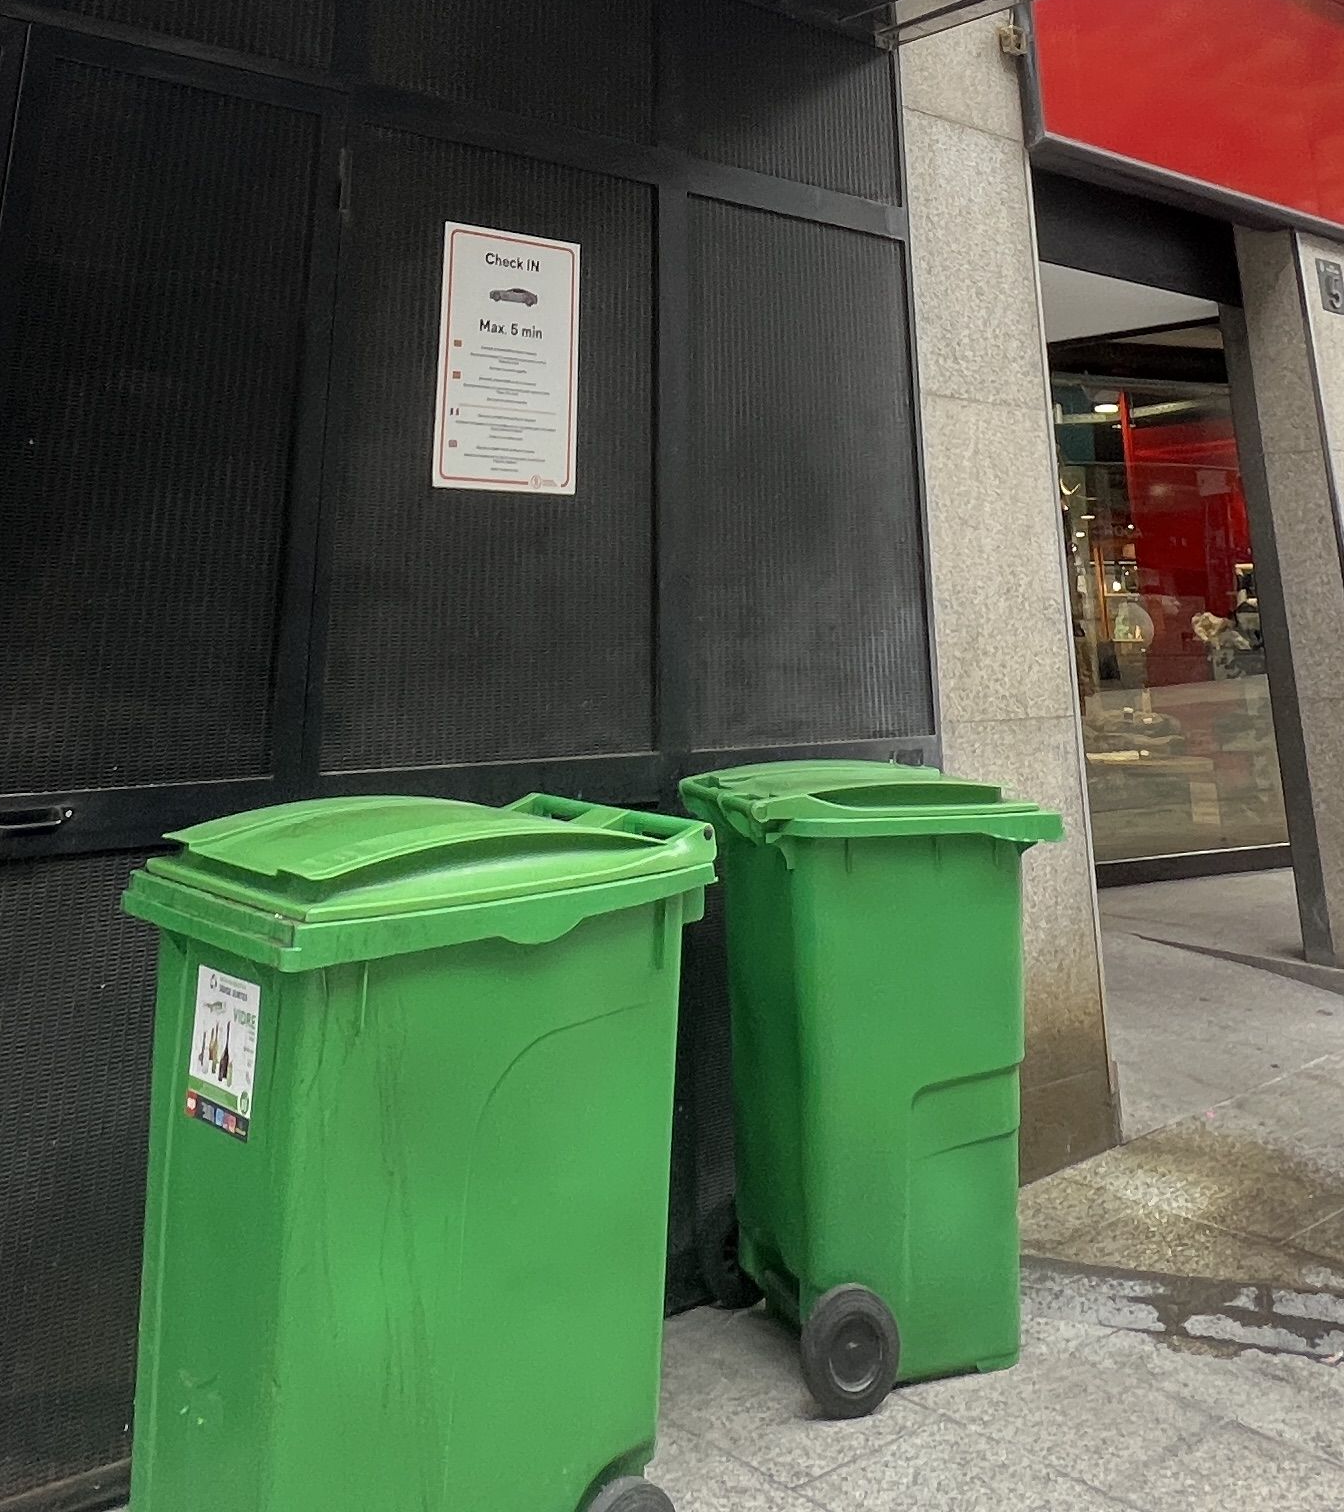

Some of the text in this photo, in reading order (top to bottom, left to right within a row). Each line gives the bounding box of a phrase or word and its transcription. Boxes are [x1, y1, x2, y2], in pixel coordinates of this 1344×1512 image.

[485, 252, 540, 273] Check IN
[479, 318, 543, 340] Max. 5 min
